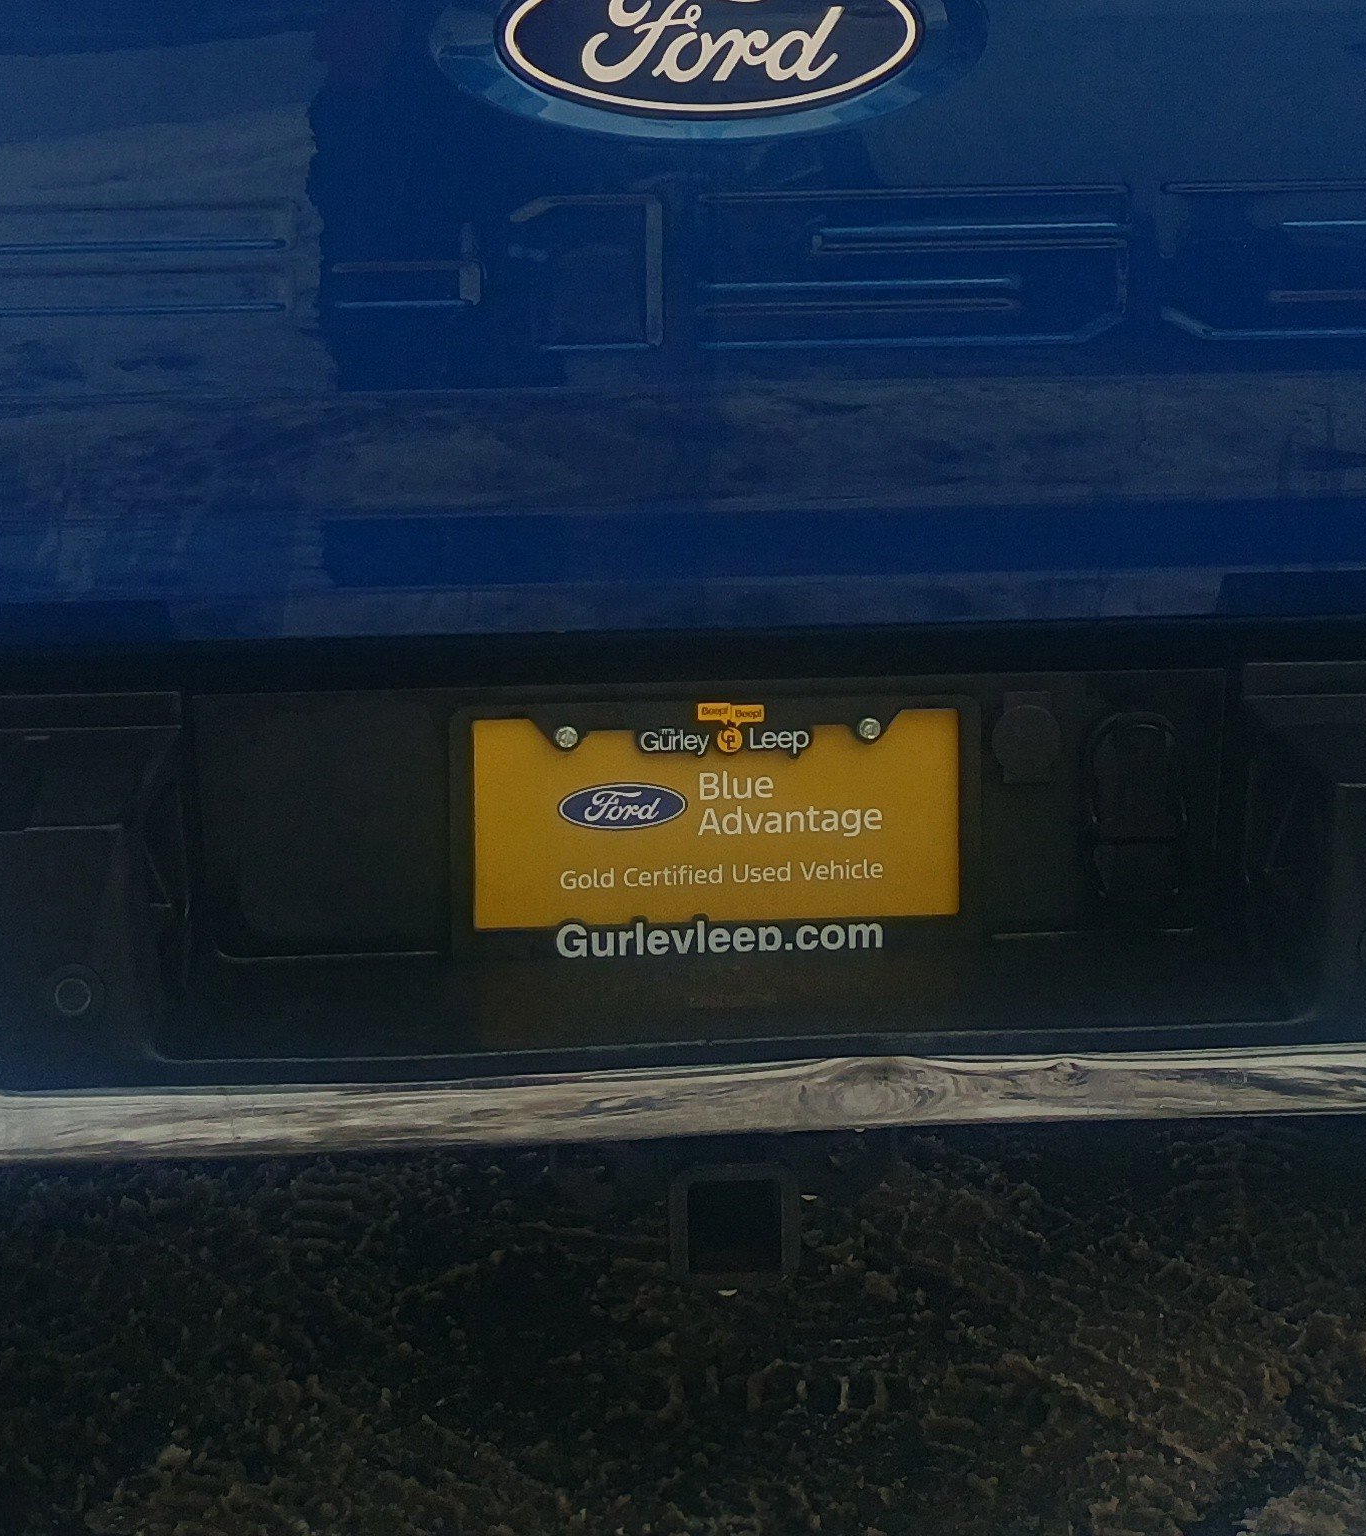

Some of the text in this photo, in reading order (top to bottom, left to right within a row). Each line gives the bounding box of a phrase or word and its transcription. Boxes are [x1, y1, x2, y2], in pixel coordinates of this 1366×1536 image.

[640, 727, 810, 756] Gurley Leep
[698, 771, 774, 801] Blue
[583, 790, 660, 822] Ford
[697, 804, 884, 837] Advantage
[560, 859, 884, 890] Gold Certified Used Vehicle
